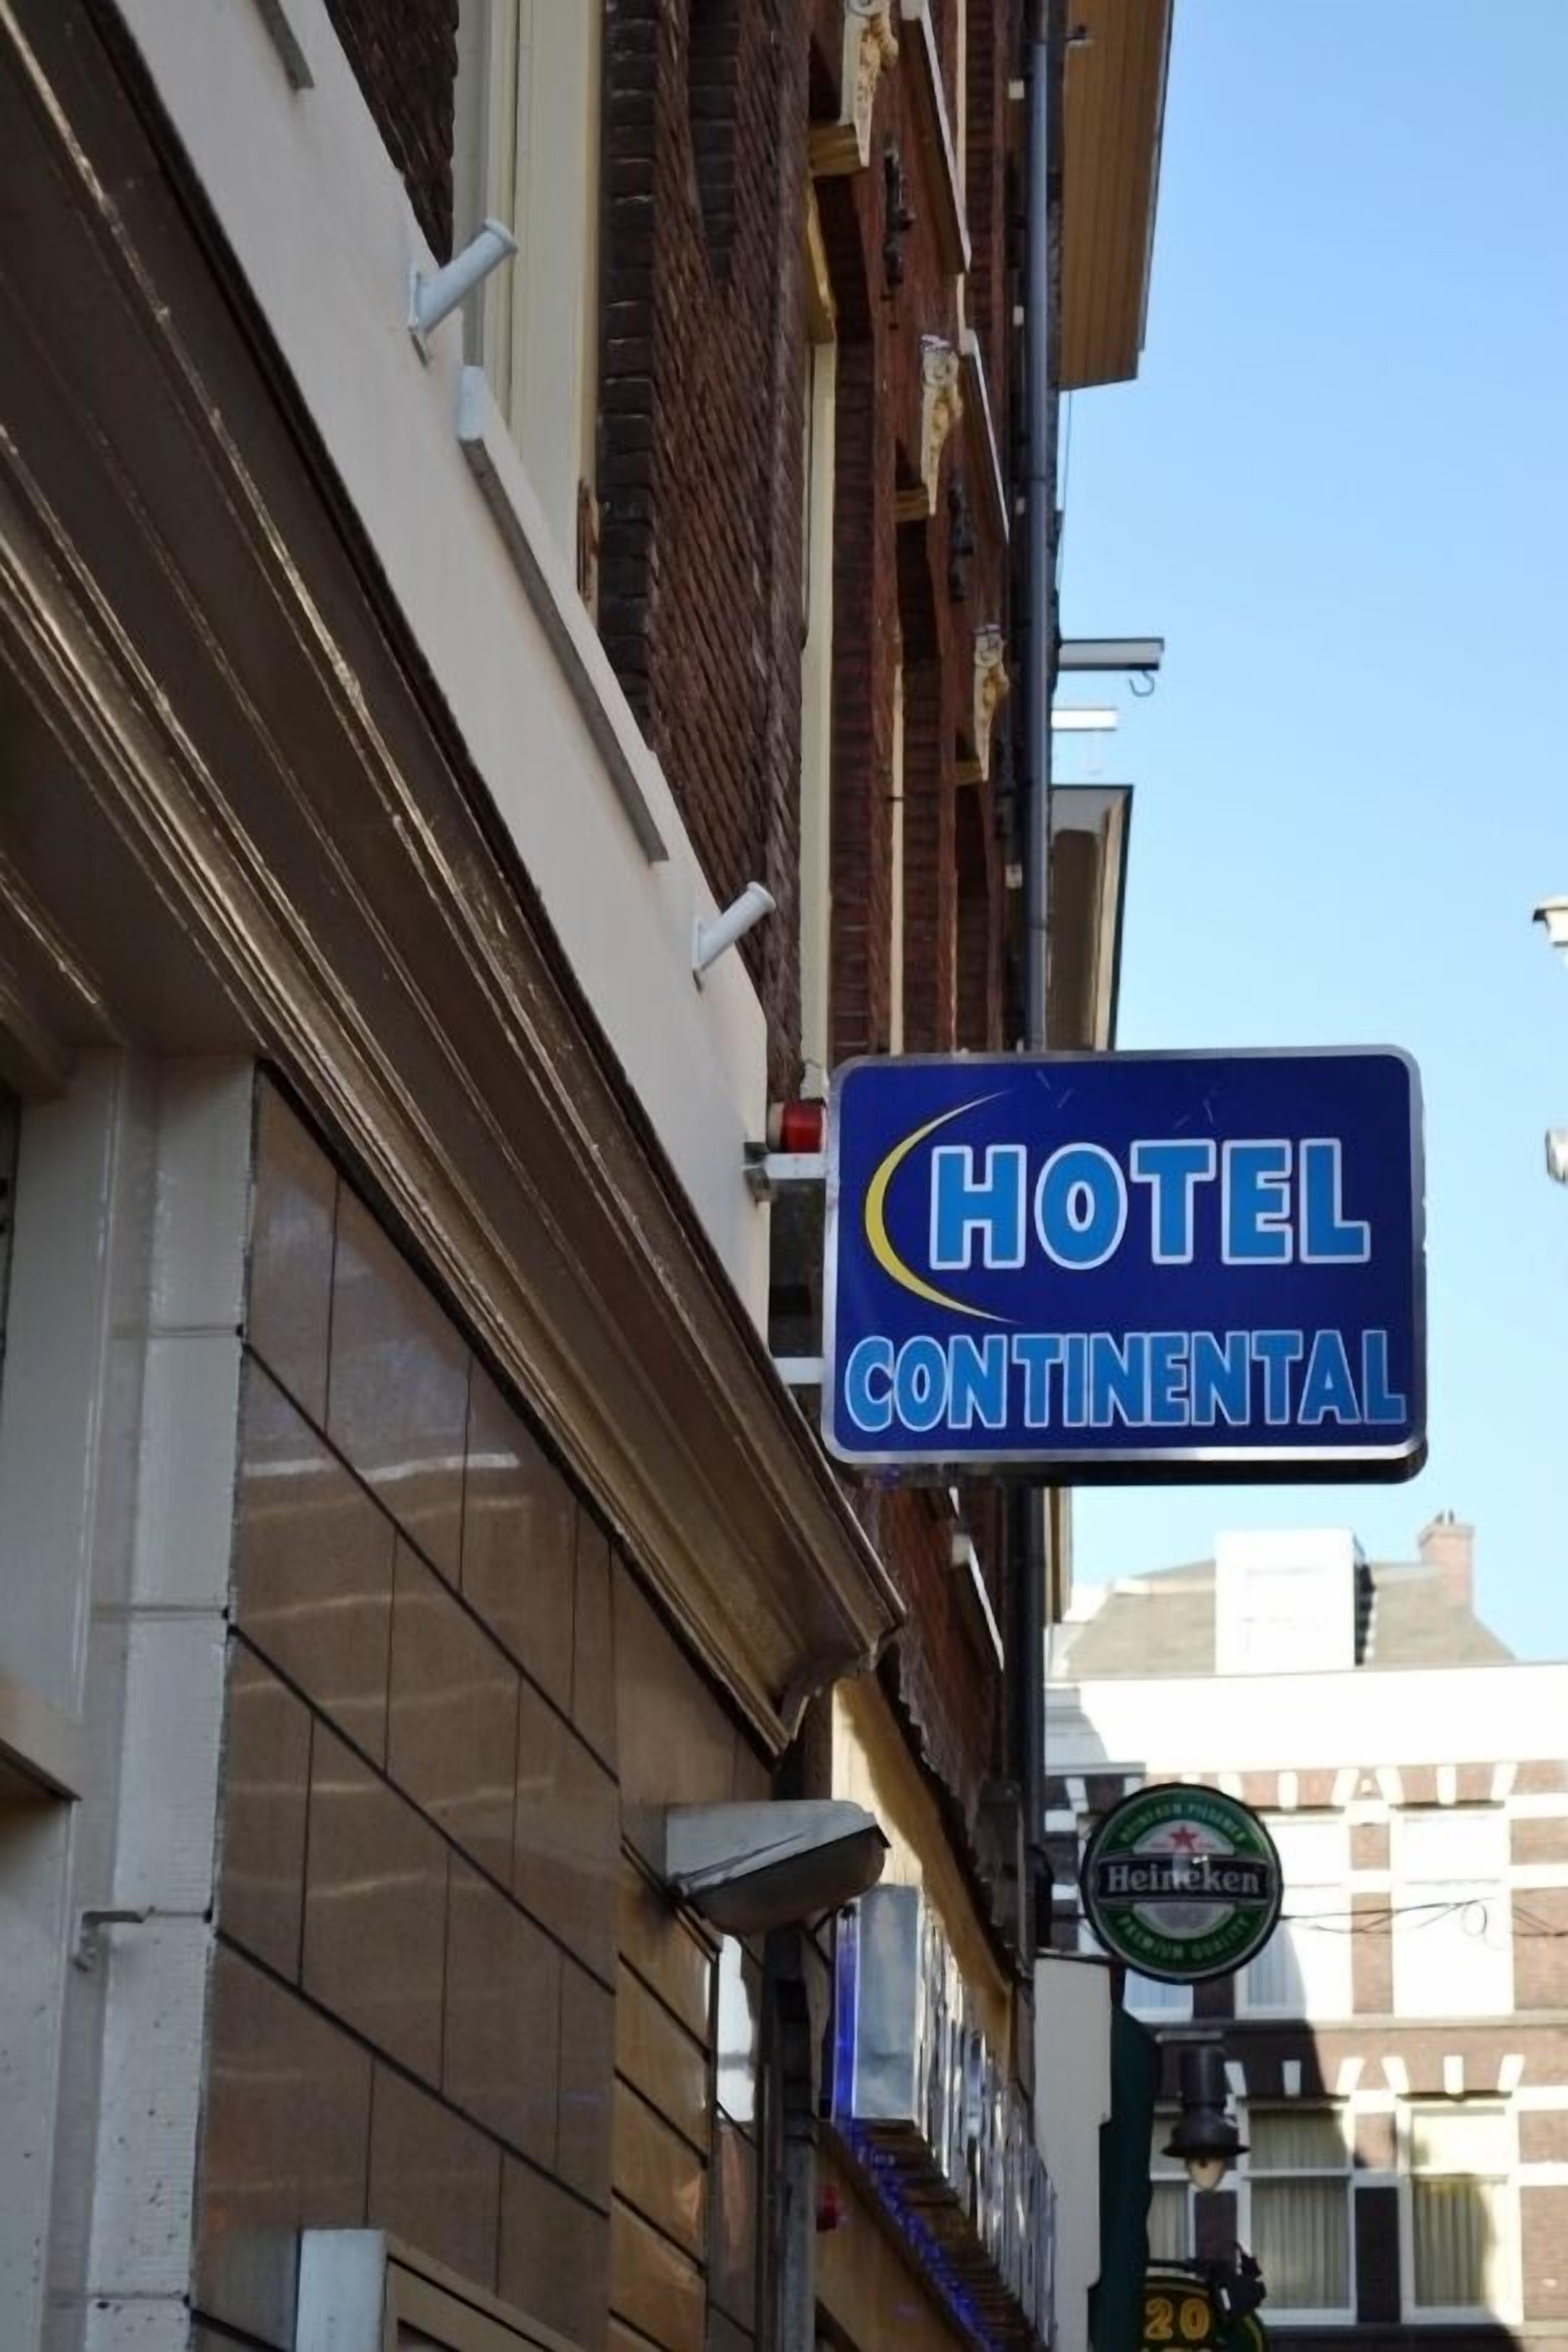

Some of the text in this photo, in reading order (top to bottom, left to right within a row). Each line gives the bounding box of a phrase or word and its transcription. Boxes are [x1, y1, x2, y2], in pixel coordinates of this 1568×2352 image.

[930, 1139, 1371, 1270] HOTEL
[844, 1330, 1407, 1431] CONTINENTAL
[1109, 1861, 1260, 1893] Heineken
[1145, 2297, 1209, 2340] 20
